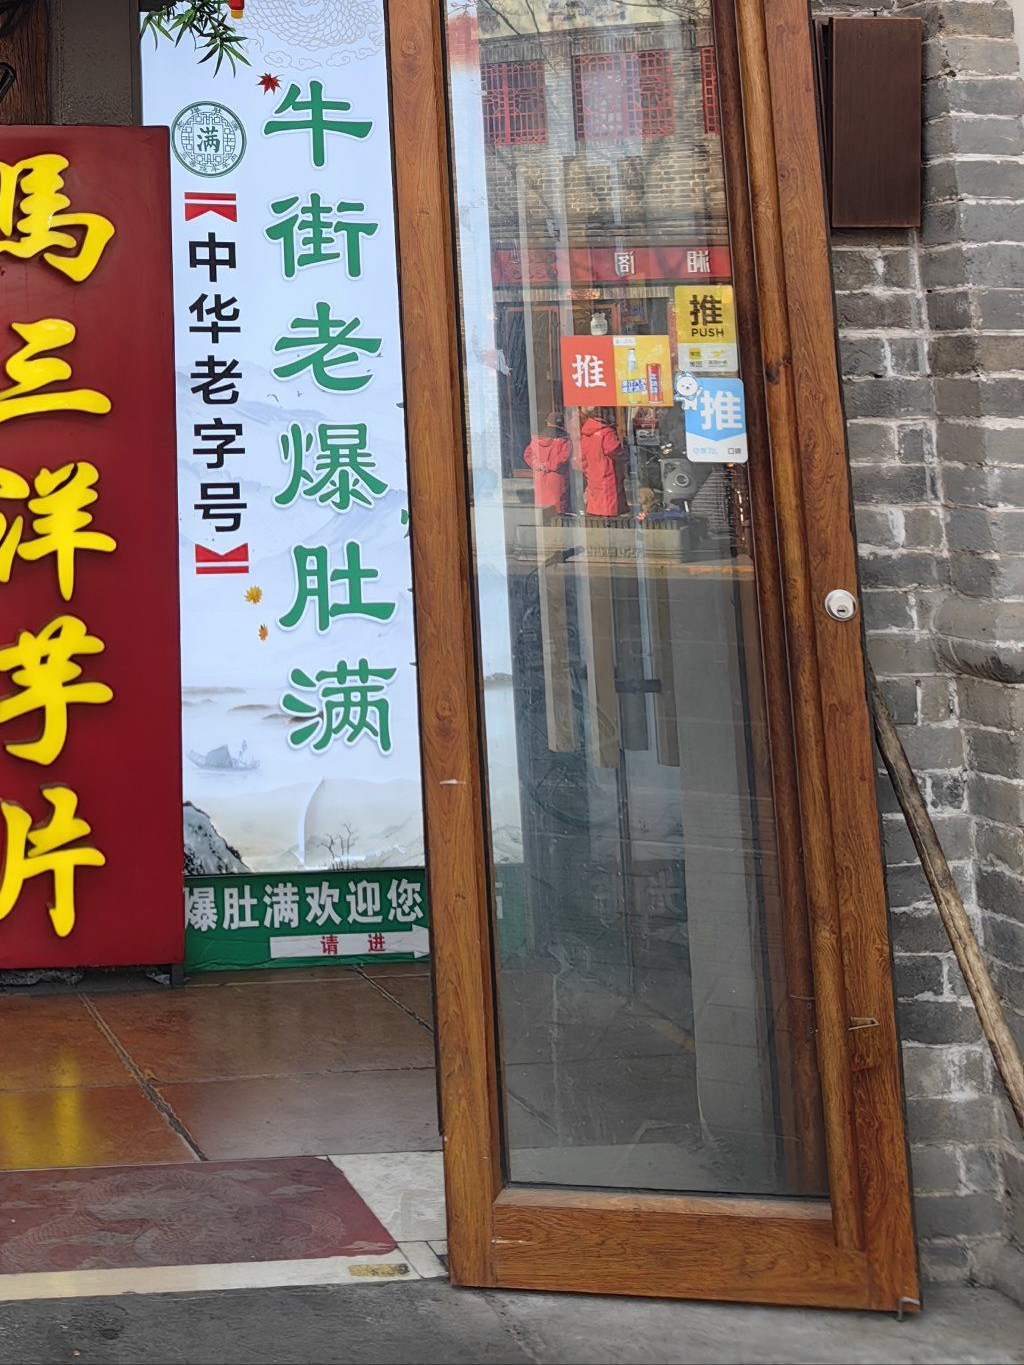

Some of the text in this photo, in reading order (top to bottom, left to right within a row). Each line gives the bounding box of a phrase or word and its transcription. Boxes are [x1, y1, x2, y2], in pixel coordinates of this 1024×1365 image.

[689, 295, 723, 326] 推
[691, 328, 724, 337] PUSH
[187, 233, 249, 533] 中华老字号
[572, 354, 607, 388] 推
[264, 81, 396, 752] 牛街老爆肚满
[700, 390, 743, 431] 推
[185, 878, 424, 932] 爆肚满欢迎您
